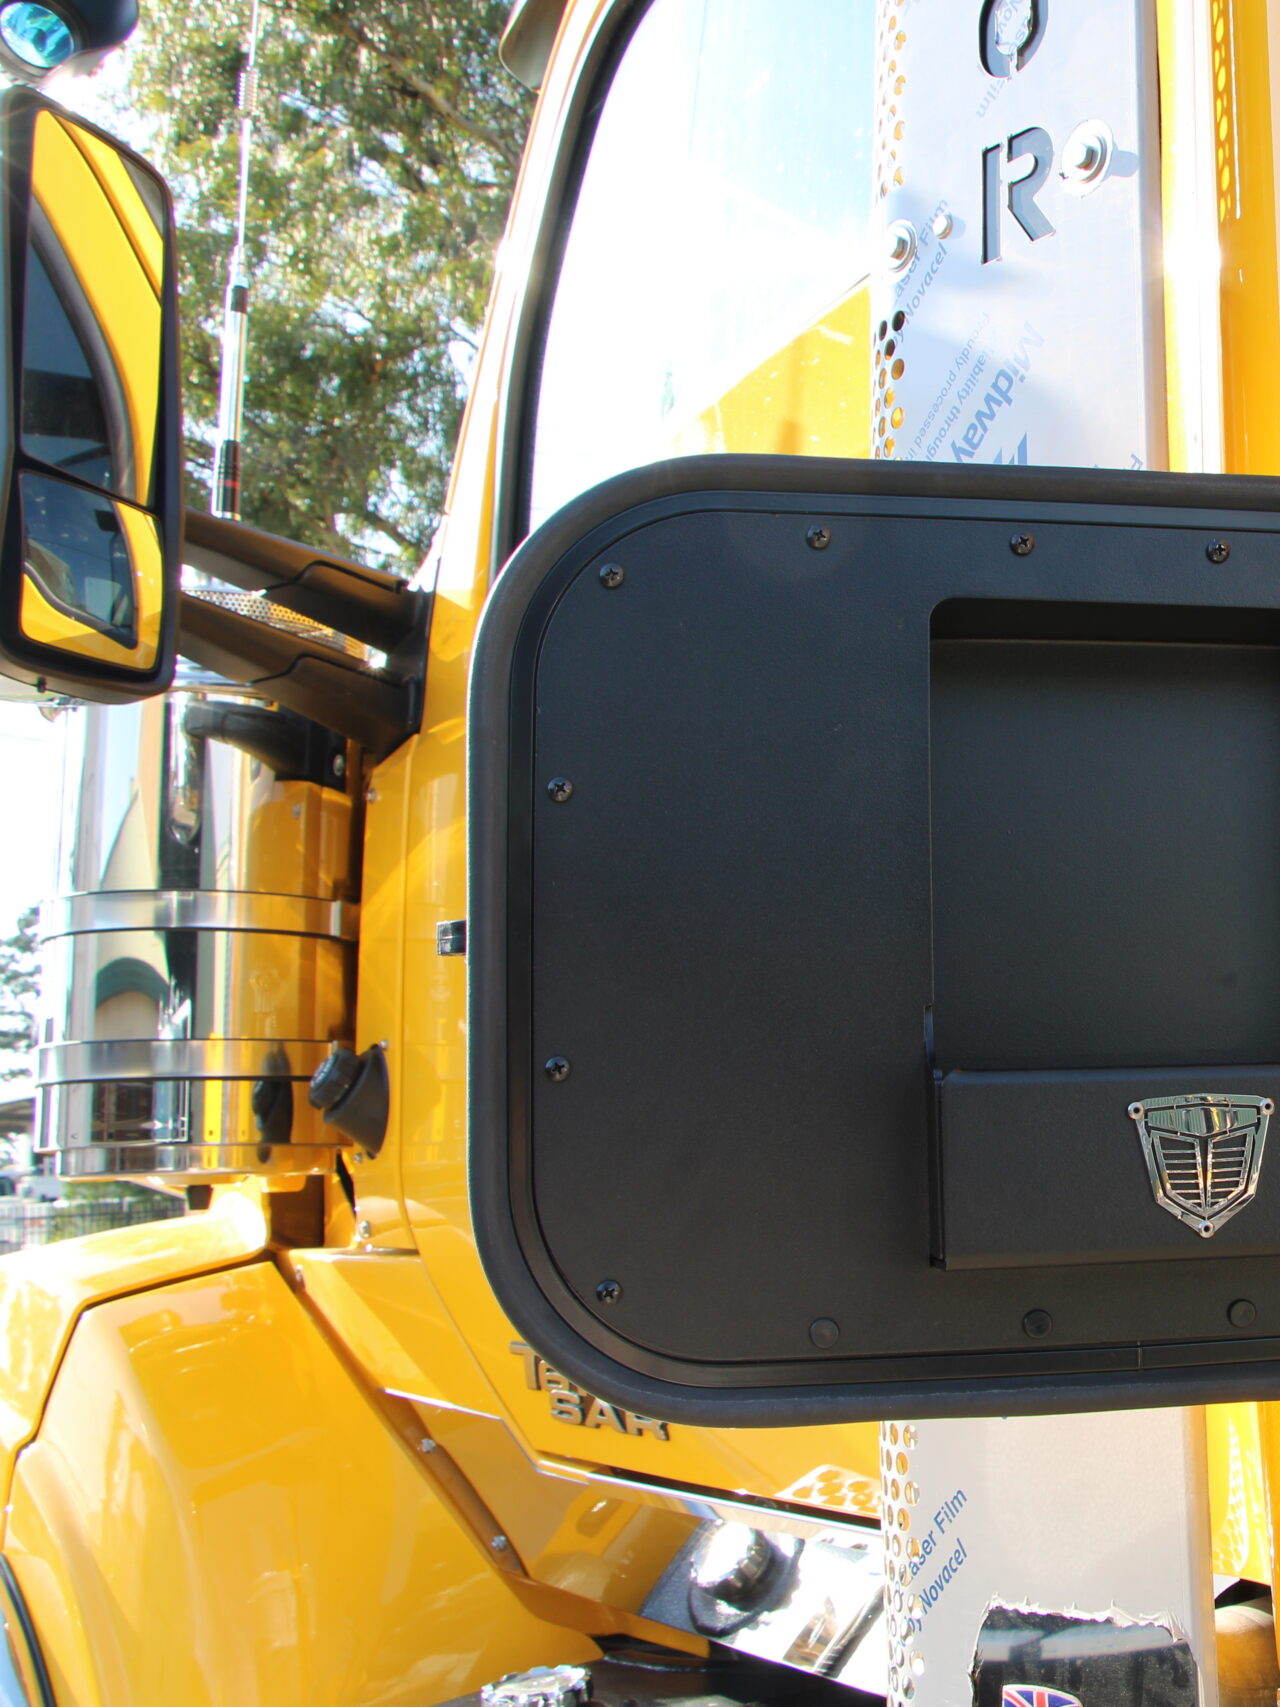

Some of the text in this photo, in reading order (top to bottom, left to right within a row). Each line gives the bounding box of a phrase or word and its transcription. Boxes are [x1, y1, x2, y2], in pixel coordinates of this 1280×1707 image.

[914, 378, 955, 446] processed
[952, 321, 1045, 464] Midway
[933, 1488, 968, 1533] Film
[918, 1538, 968, 1615] Novacel
